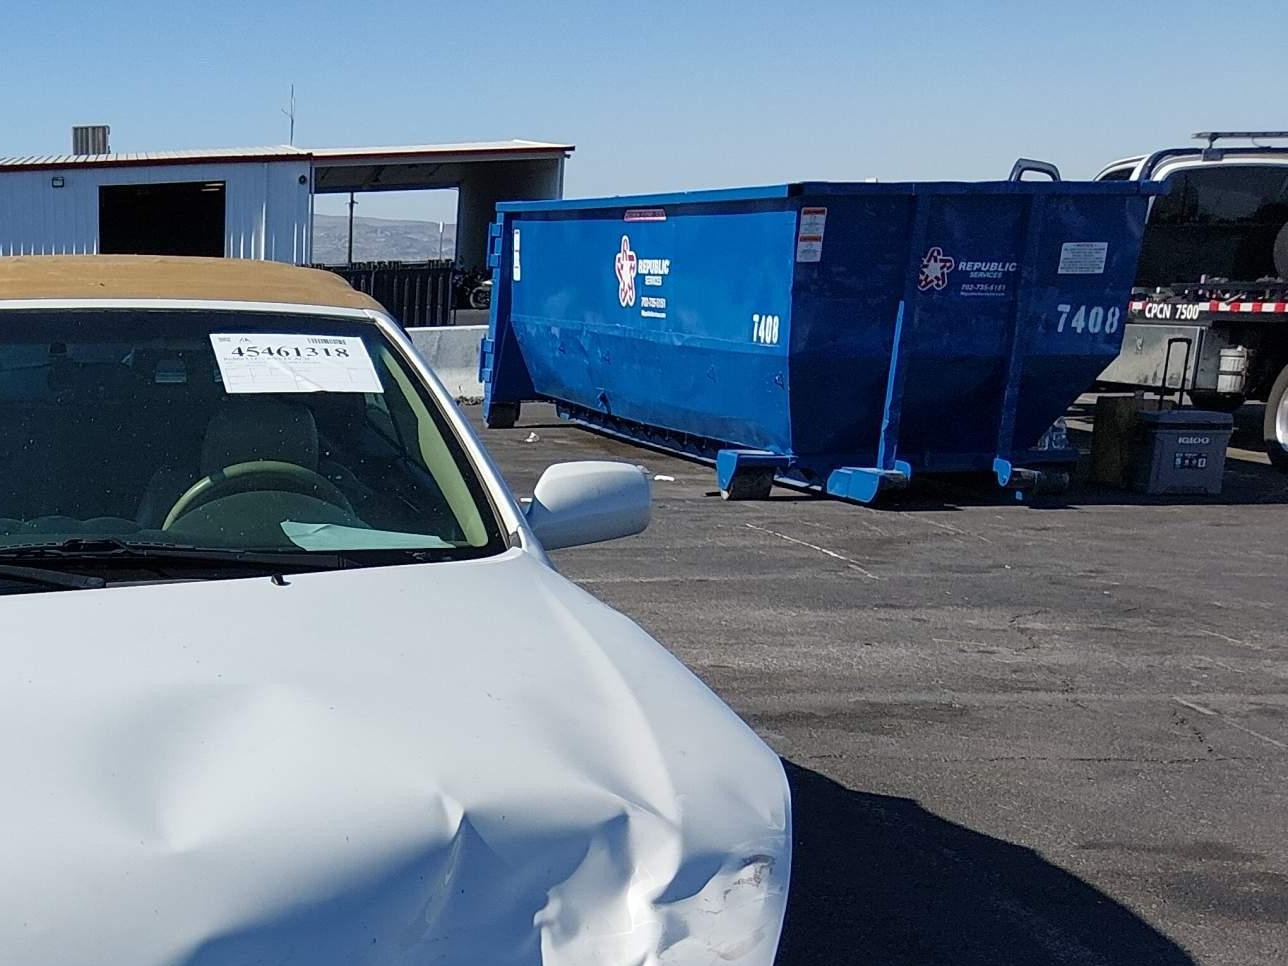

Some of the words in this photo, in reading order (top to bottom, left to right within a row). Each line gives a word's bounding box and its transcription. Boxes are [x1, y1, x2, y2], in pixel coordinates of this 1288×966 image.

[638, 259, 670, 275] REPUBLIC
[958, 261, 1017, 271] REPUBLIC
[1057, 304, 1120, 334] 7408
[1145, 302, 1171, 318] CPCN
[1175, 304, 1199, 320] 7500
[752, 314, 780, 344] 7408
[231, 345, 350, 357] 45461318
